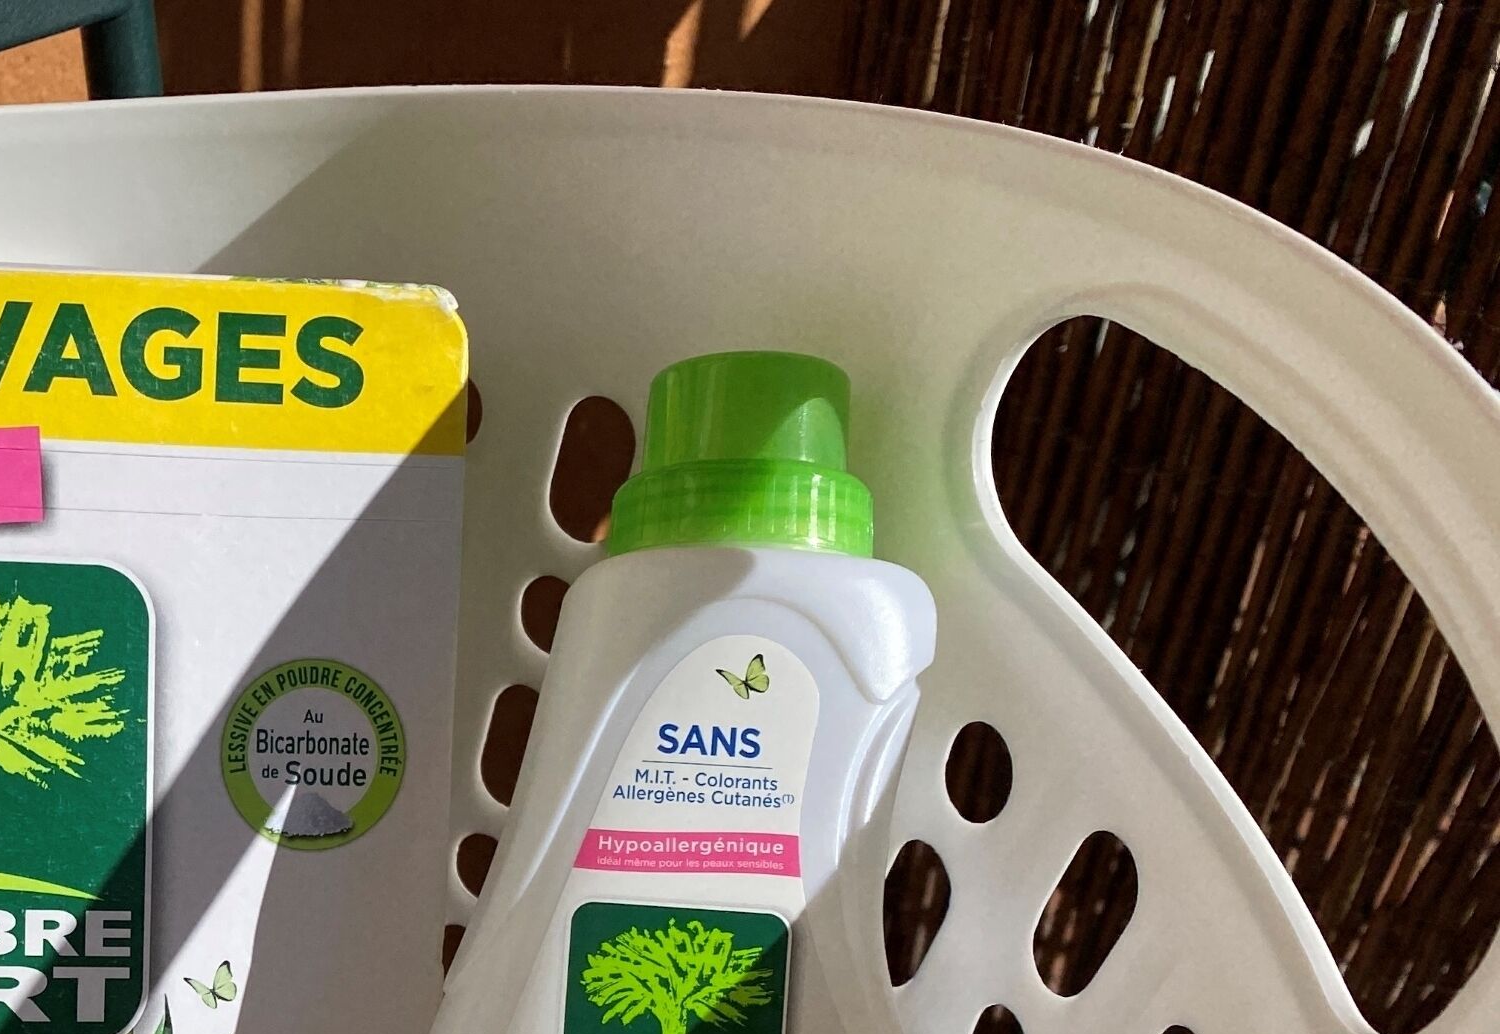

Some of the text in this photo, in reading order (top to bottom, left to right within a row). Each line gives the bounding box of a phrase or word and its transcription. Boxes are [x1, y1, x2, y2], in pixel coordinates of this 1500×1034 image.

[228, 666, 402, 777] LESSIVE EN POUDRE CONCENTRÉE
[303, 710, 323, 723] Au
[256, 729, 369, 755] Bicarbonate
[657, 723, 761, 759] SANS
[262, 761, 366, 786] de Soude
[635, 769, 676, 785] M.I.T.
[695, 773, 778, 791] Colorants
[613, 785, 705, 804] Allergènes
[599, 836, 784, 856] Hypoallergénique
[597, 857, 784, 870] idéal même pour les peaux sensibles
